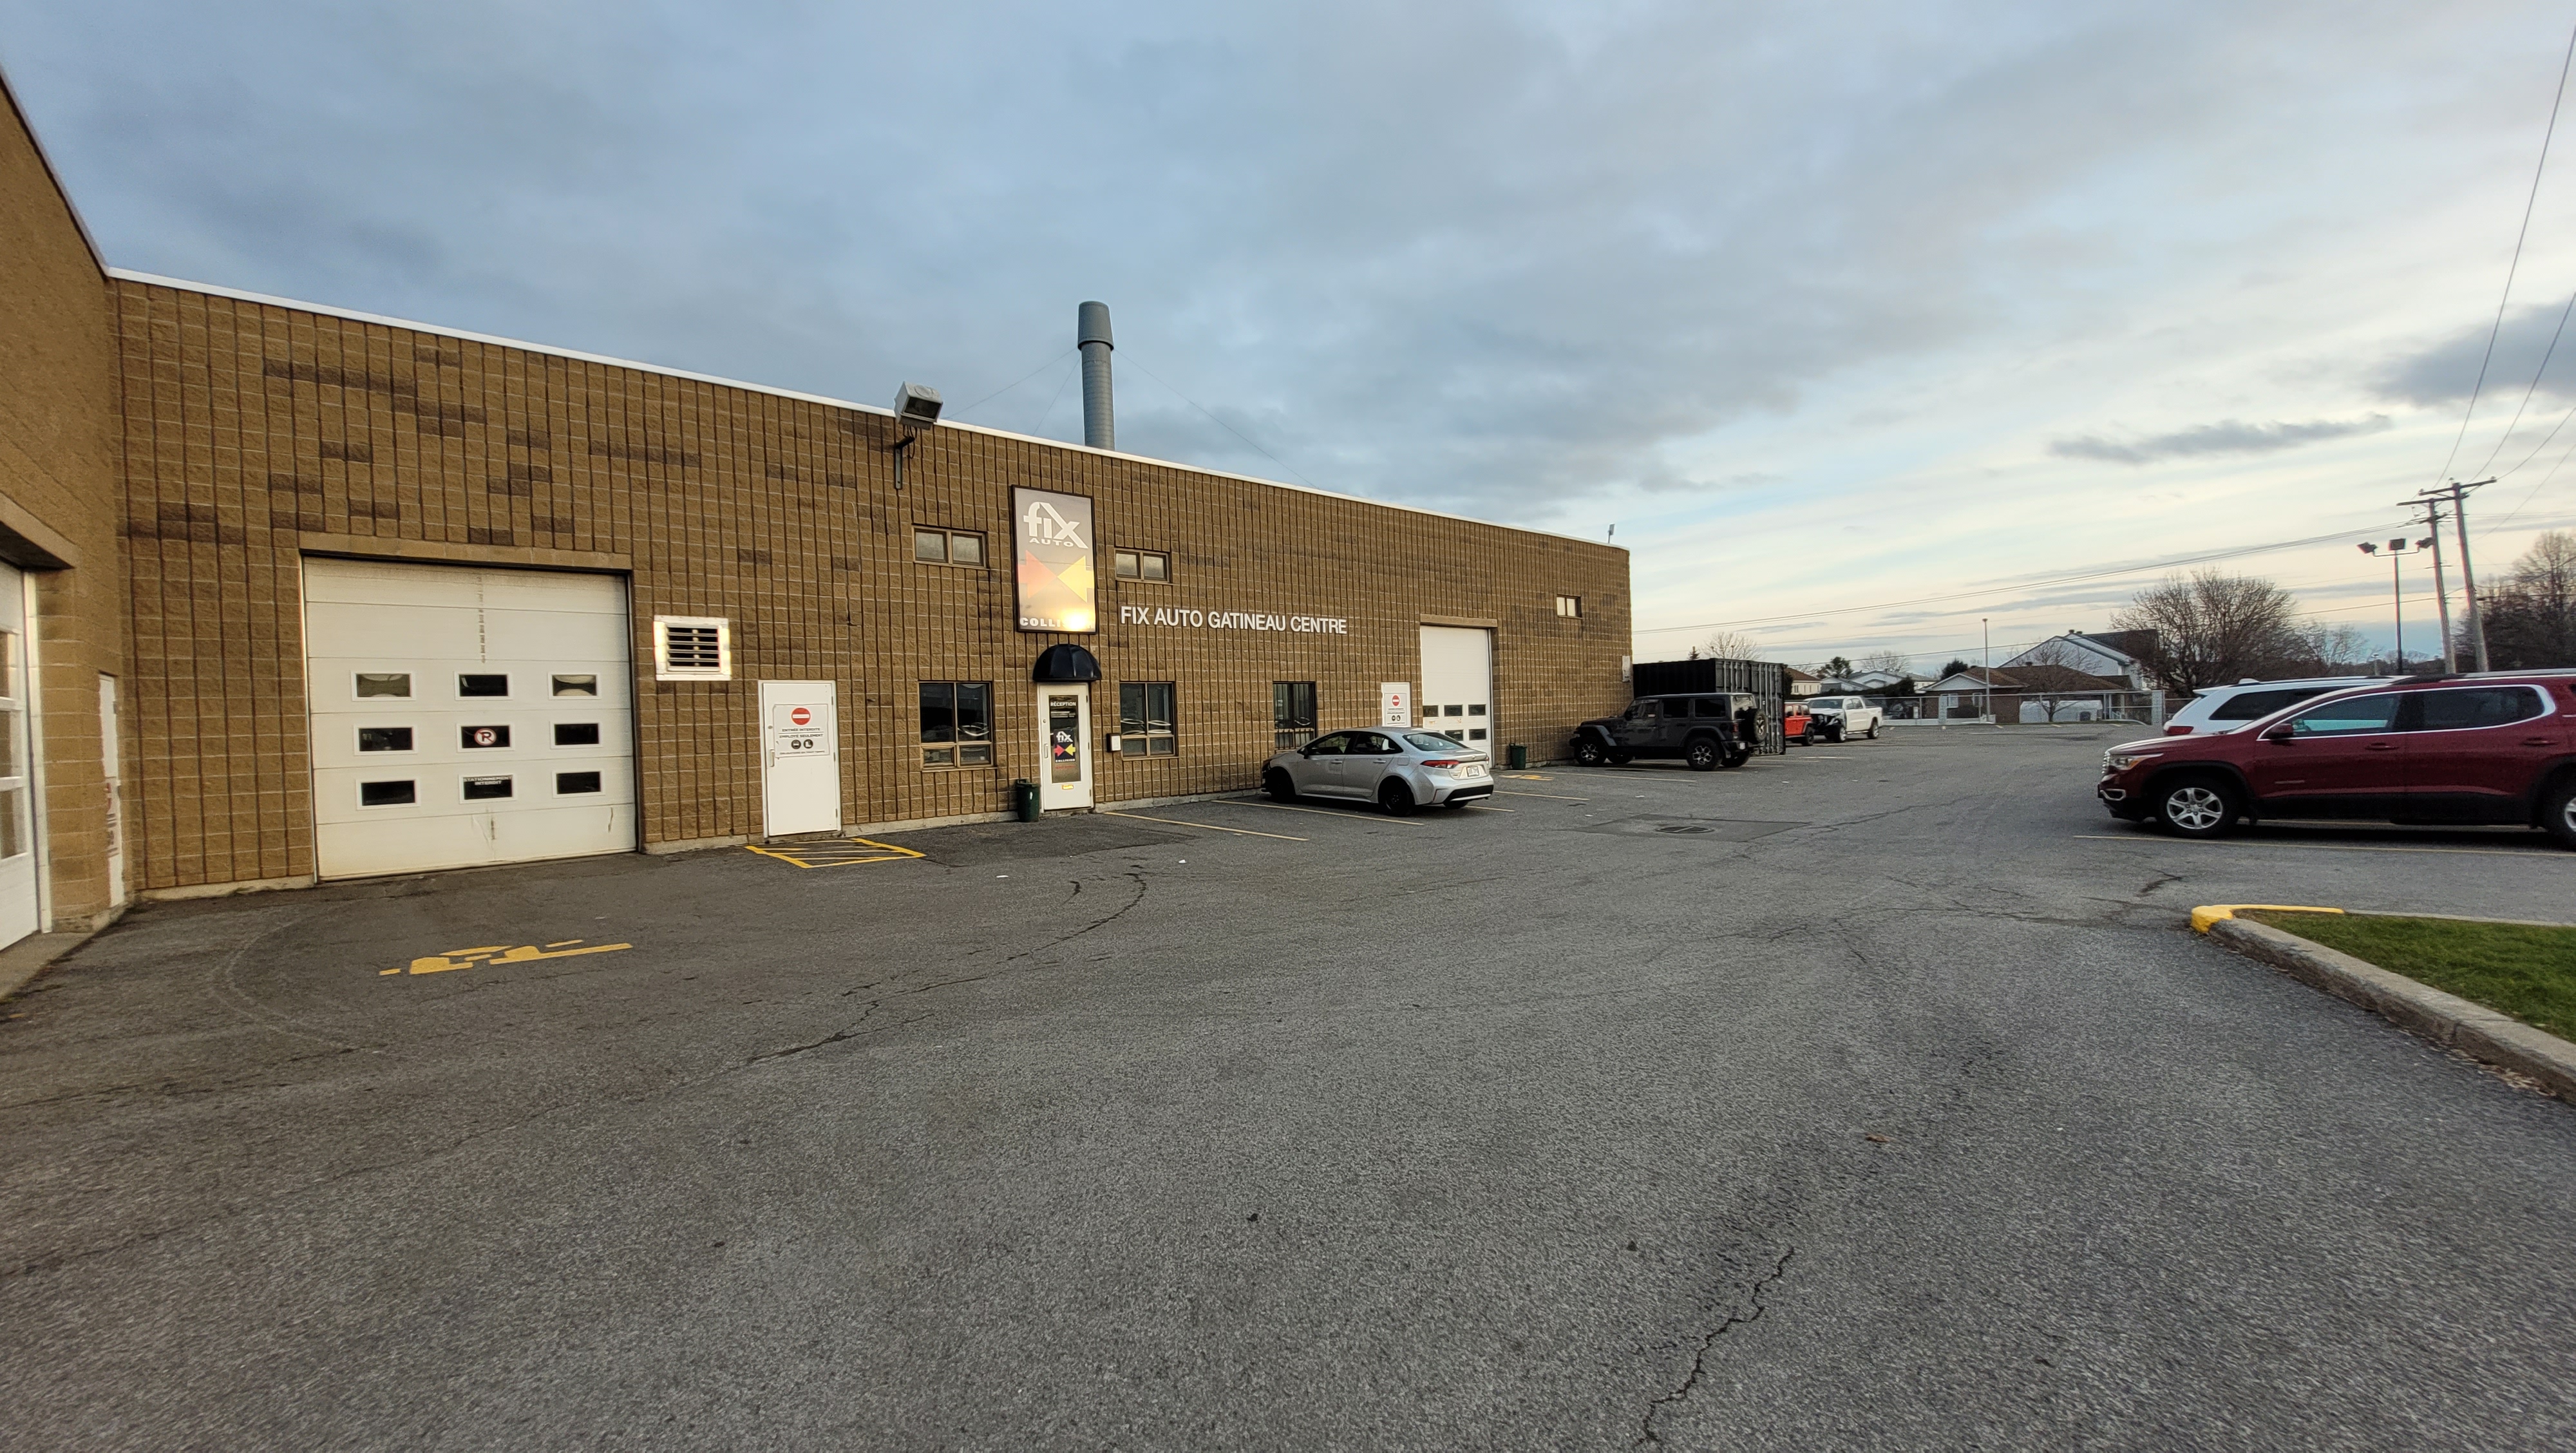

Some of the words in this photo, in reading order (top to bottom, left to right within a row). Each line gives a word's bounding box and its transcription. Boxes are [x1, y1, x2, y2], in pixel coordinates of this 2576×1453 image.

[1023, 502, 1088, 549] fix
[1029, 538, 1074, 547] AUTO
[1019, 618, 1095, 629] COLLI
[1121, 606, 1150, 625] FIX
[1154, 608, 1203, 628] AUTO
[1208, 611, 1286, 631] GATINEAU
[1290, 616, 1348, 634] CENTRE
